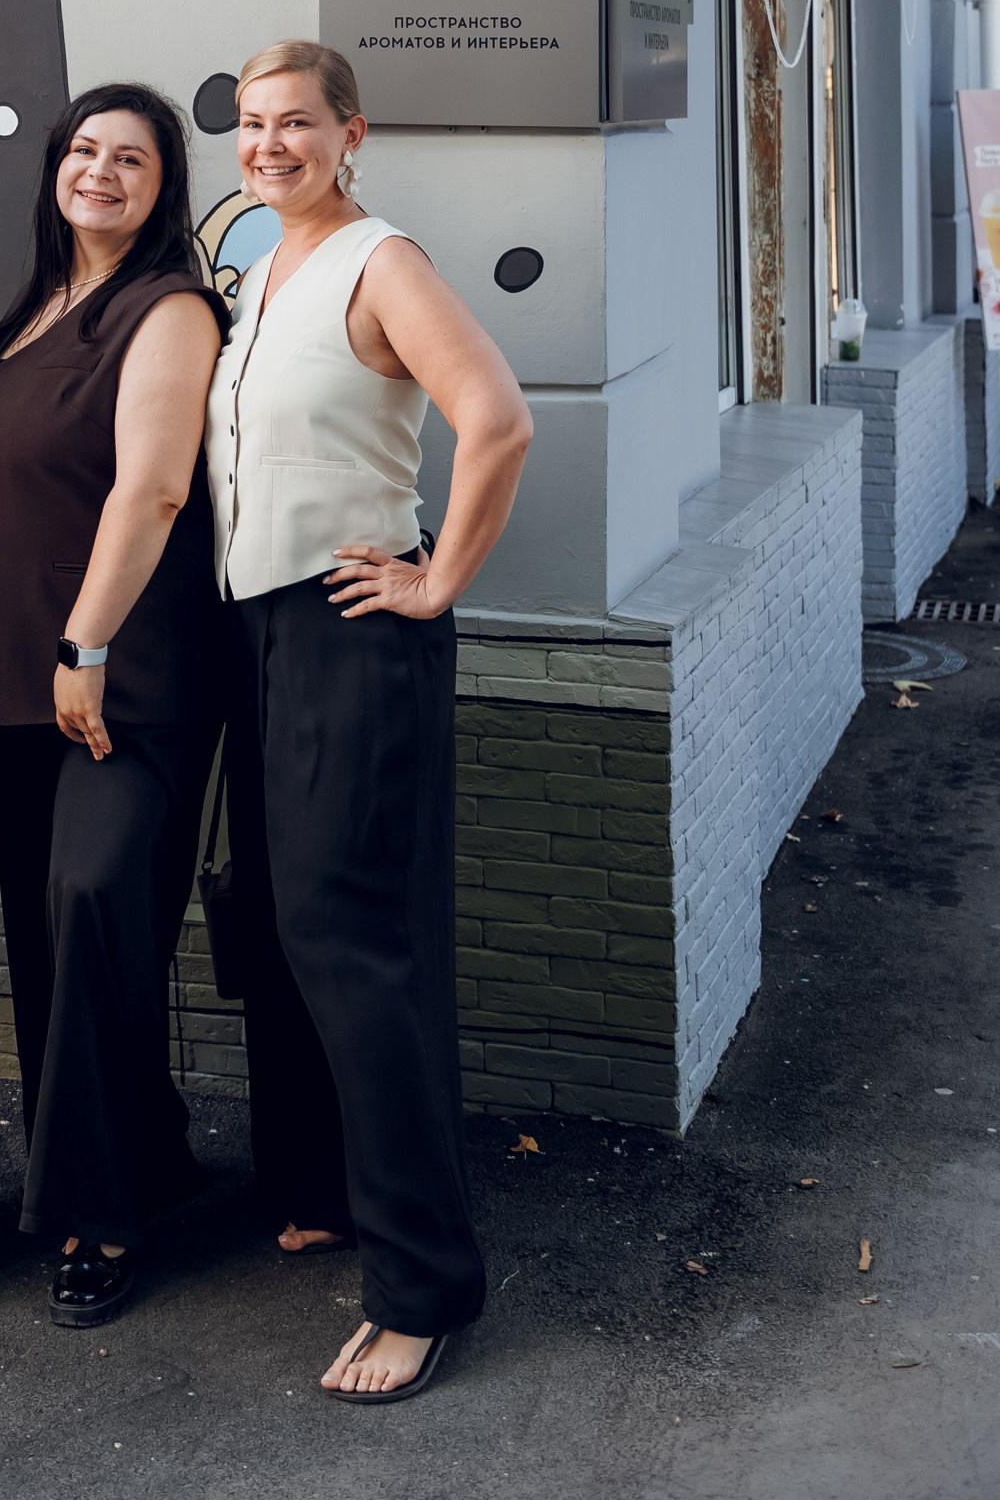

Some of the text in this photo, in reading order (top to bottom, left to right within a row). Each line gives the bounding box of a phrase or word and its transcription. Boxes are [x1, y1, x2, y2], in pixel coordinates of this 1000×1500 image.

[394, 16, 522, 29] ПРОСТРАНСТВО
[358, 36, 560, 49] АРОМАТОВ И ИНТЕРЬЕРА
